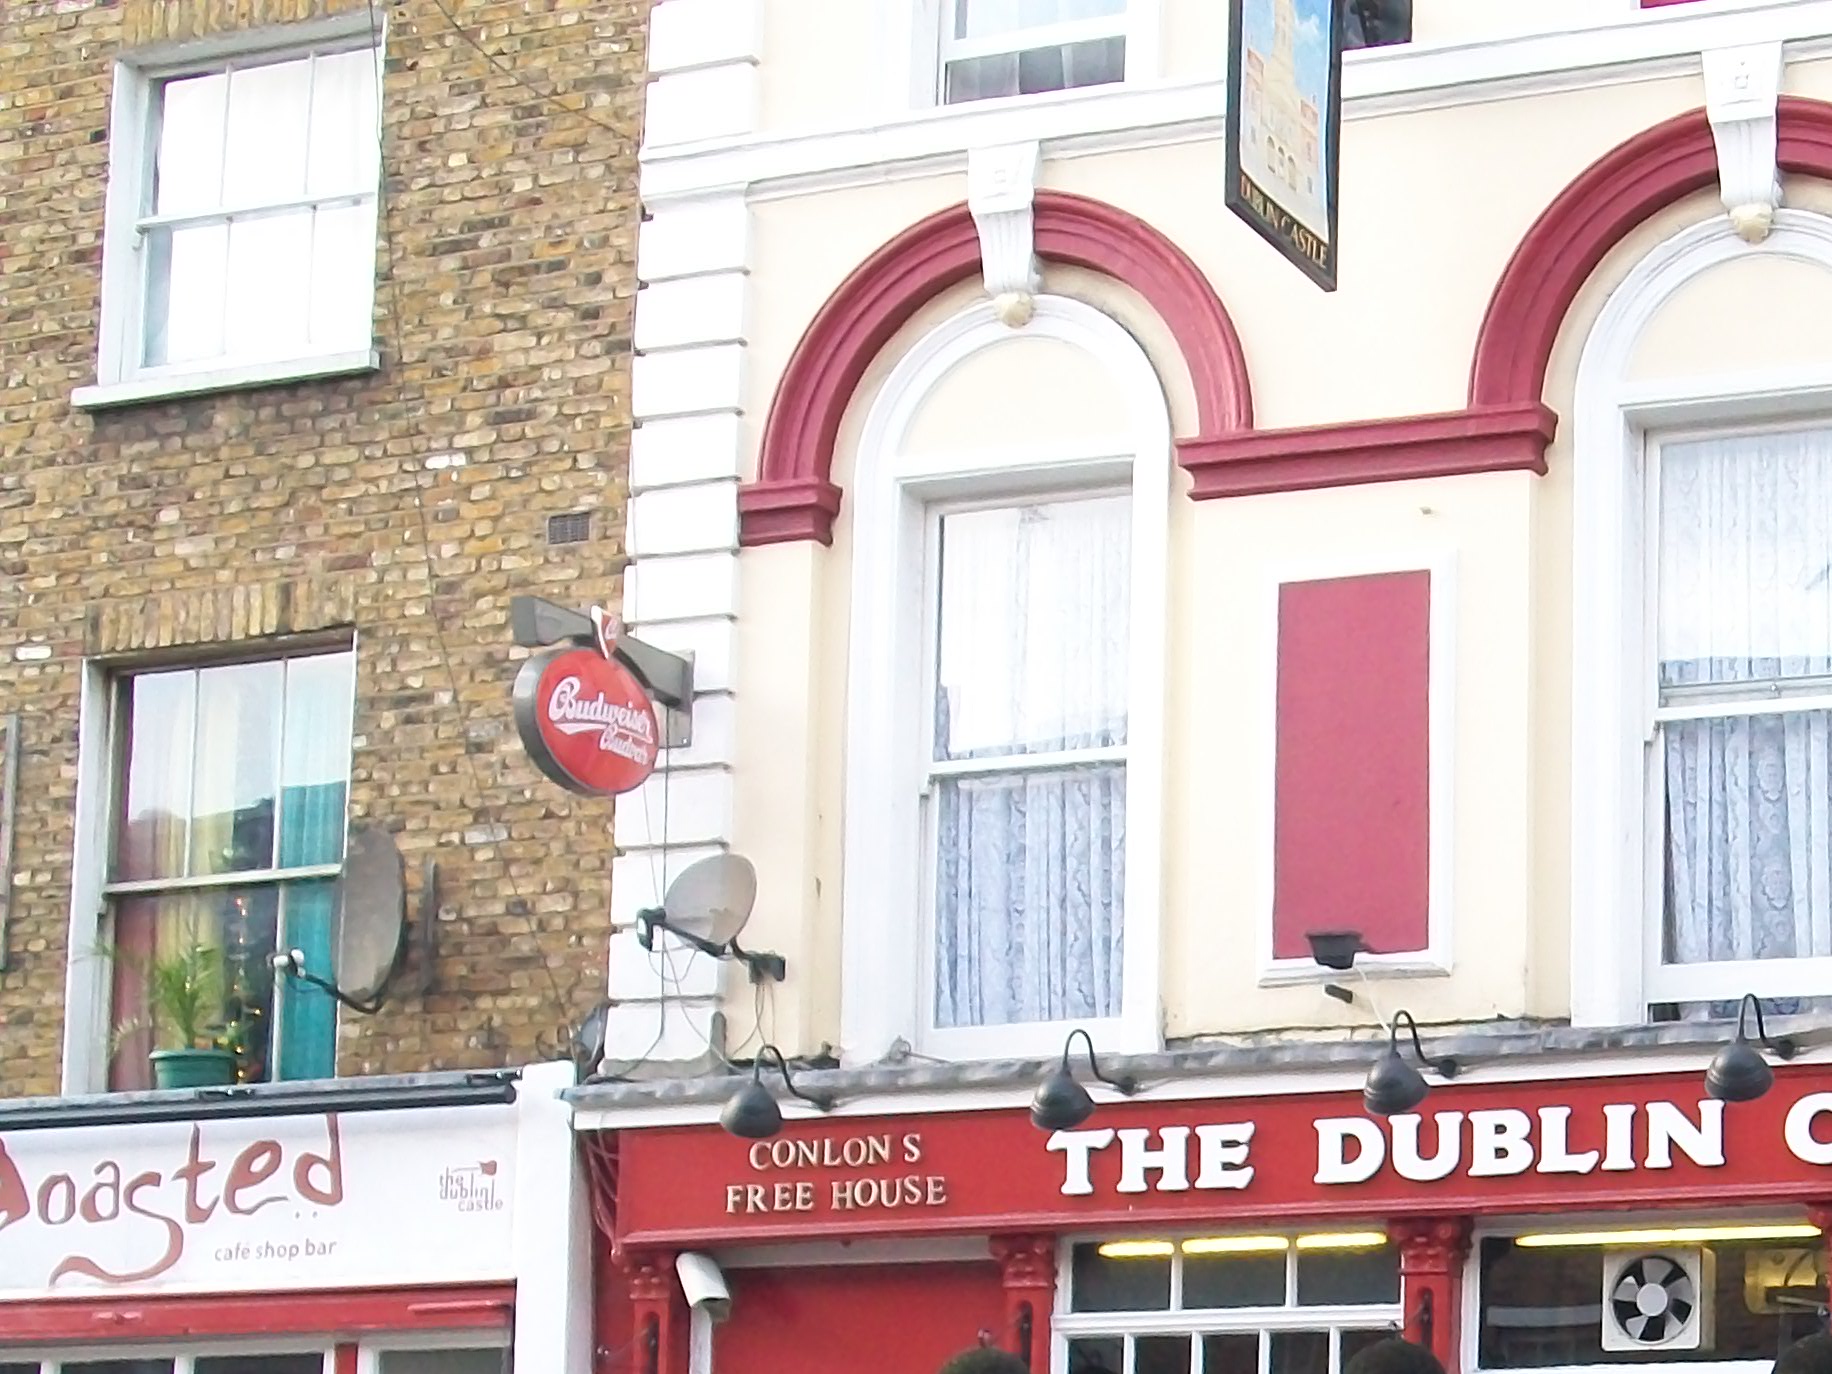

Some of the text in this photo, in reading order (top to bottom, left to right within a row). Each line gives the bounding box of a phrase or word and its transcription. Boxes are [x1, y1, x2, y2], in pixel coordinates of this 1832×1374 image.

[1280, 214, 1328, 269] CASTLE
[548, 676, 653, 737] Budweiser
[1046, 1120, 1256, 1196] THE
[1312, 1099, 1727, 1185] DUBLIN
[725, 1175, 948, 1214] FREE HOUSE
[256, 1241, 300, 1262] shop
[305, 1238, 338, 1256] bar
